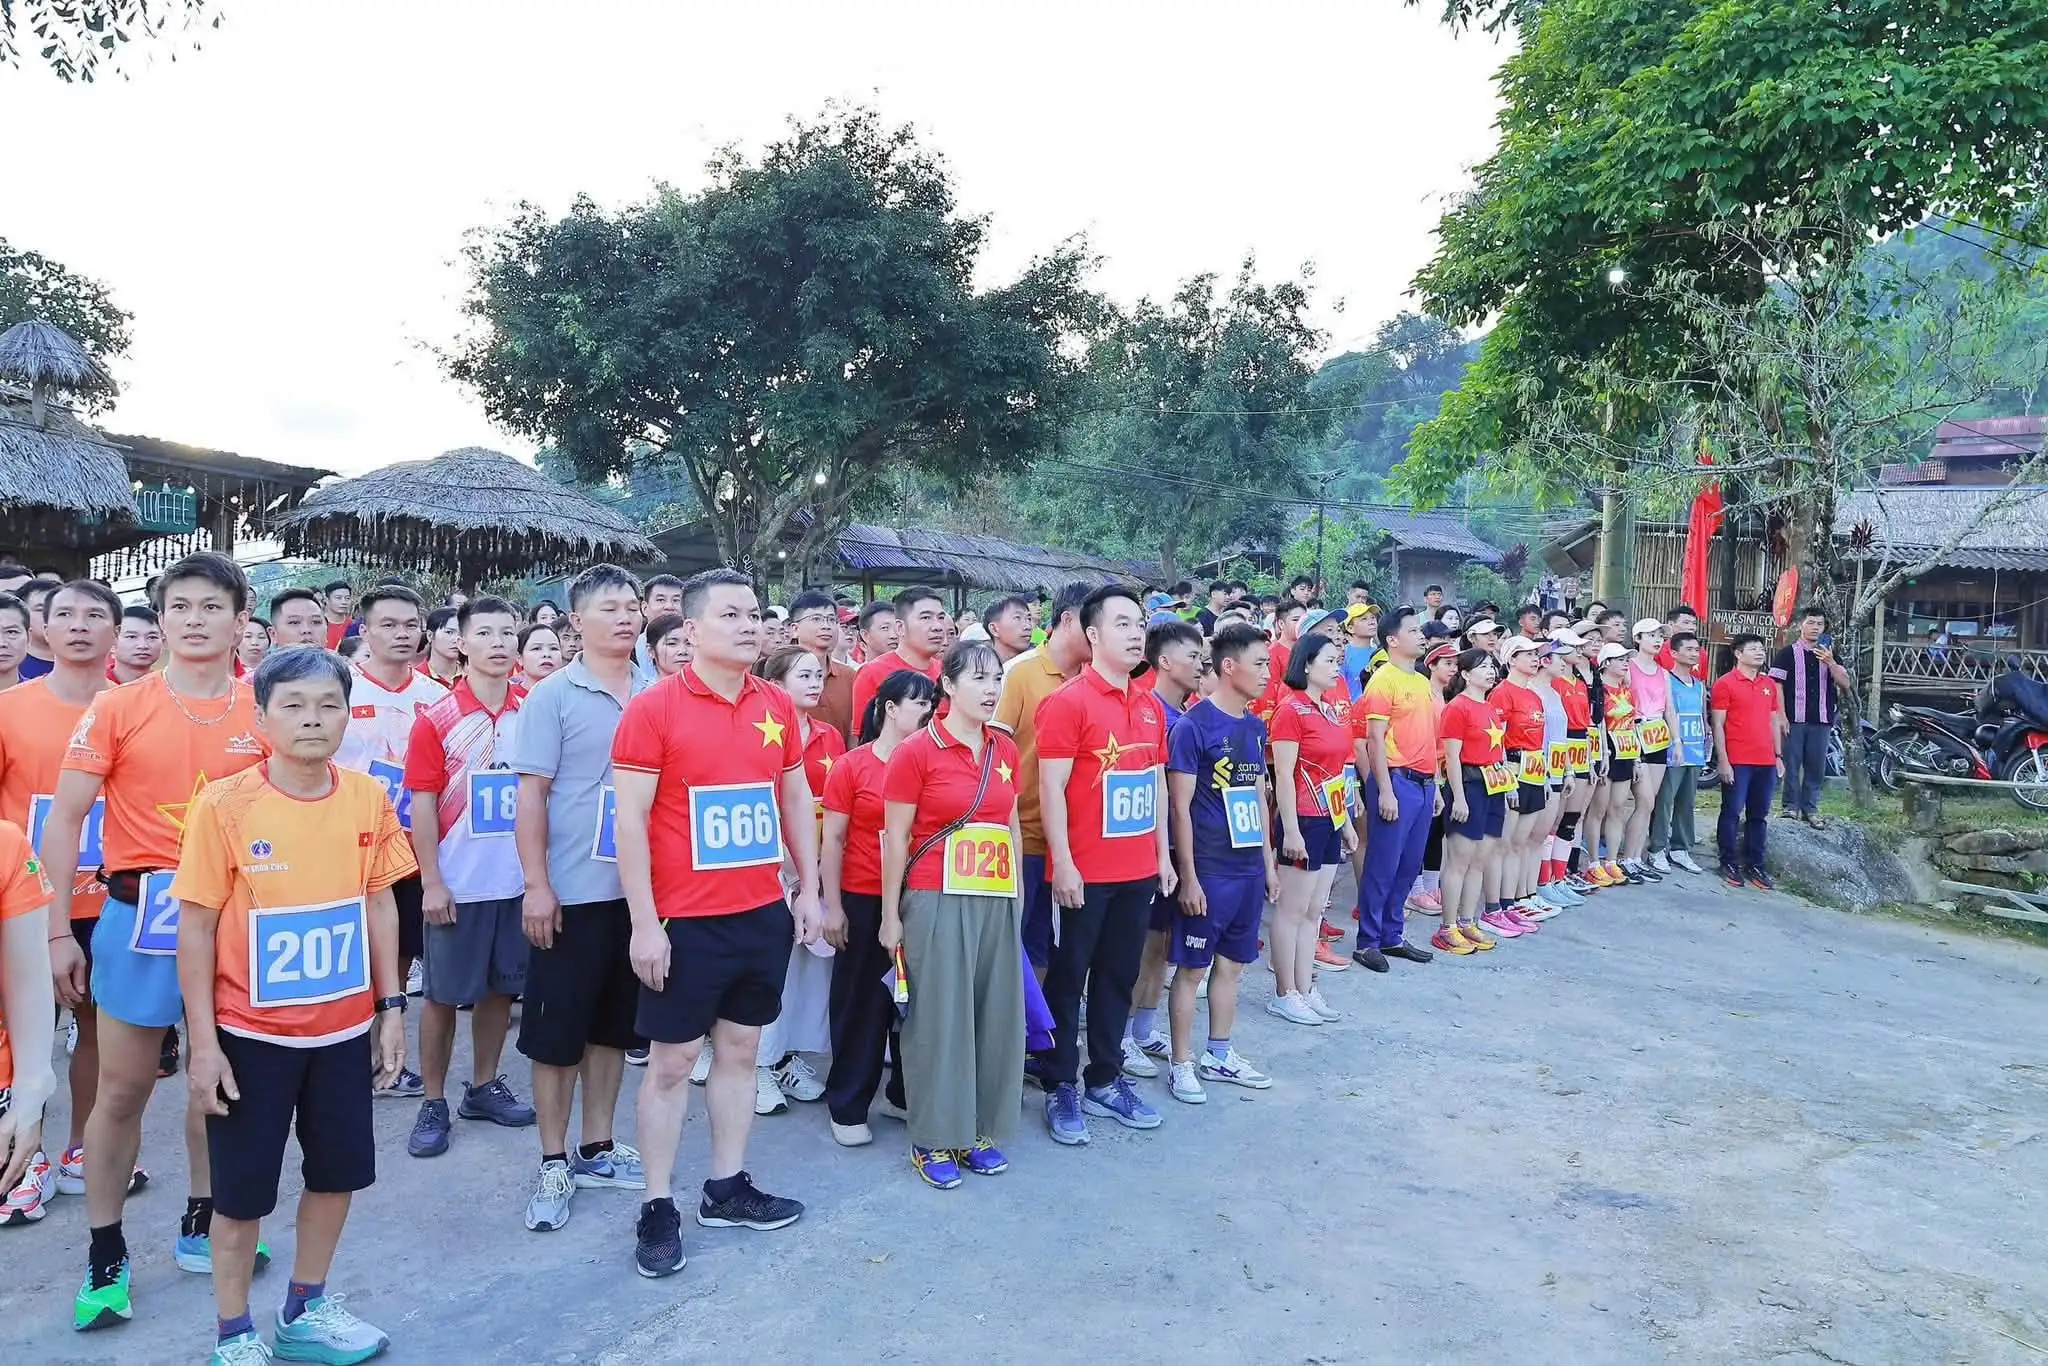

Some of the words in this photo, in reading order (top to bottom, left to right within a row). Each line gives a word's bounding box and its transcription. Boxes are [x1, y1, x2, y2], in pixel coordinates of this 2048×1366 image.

[143, 490, 190, 525] COFFEE
[1753, 625, 1779, 638] TOILET
[1643, 726, 1669, 745] 022
[1112, 783, 1153, 821] 669
[703, 802, 773, 849] 666
[954, 839, 1010, 880] 028
[266, 921, 356, 984] 207
[1185, 934, 1207, 950] SPORT
